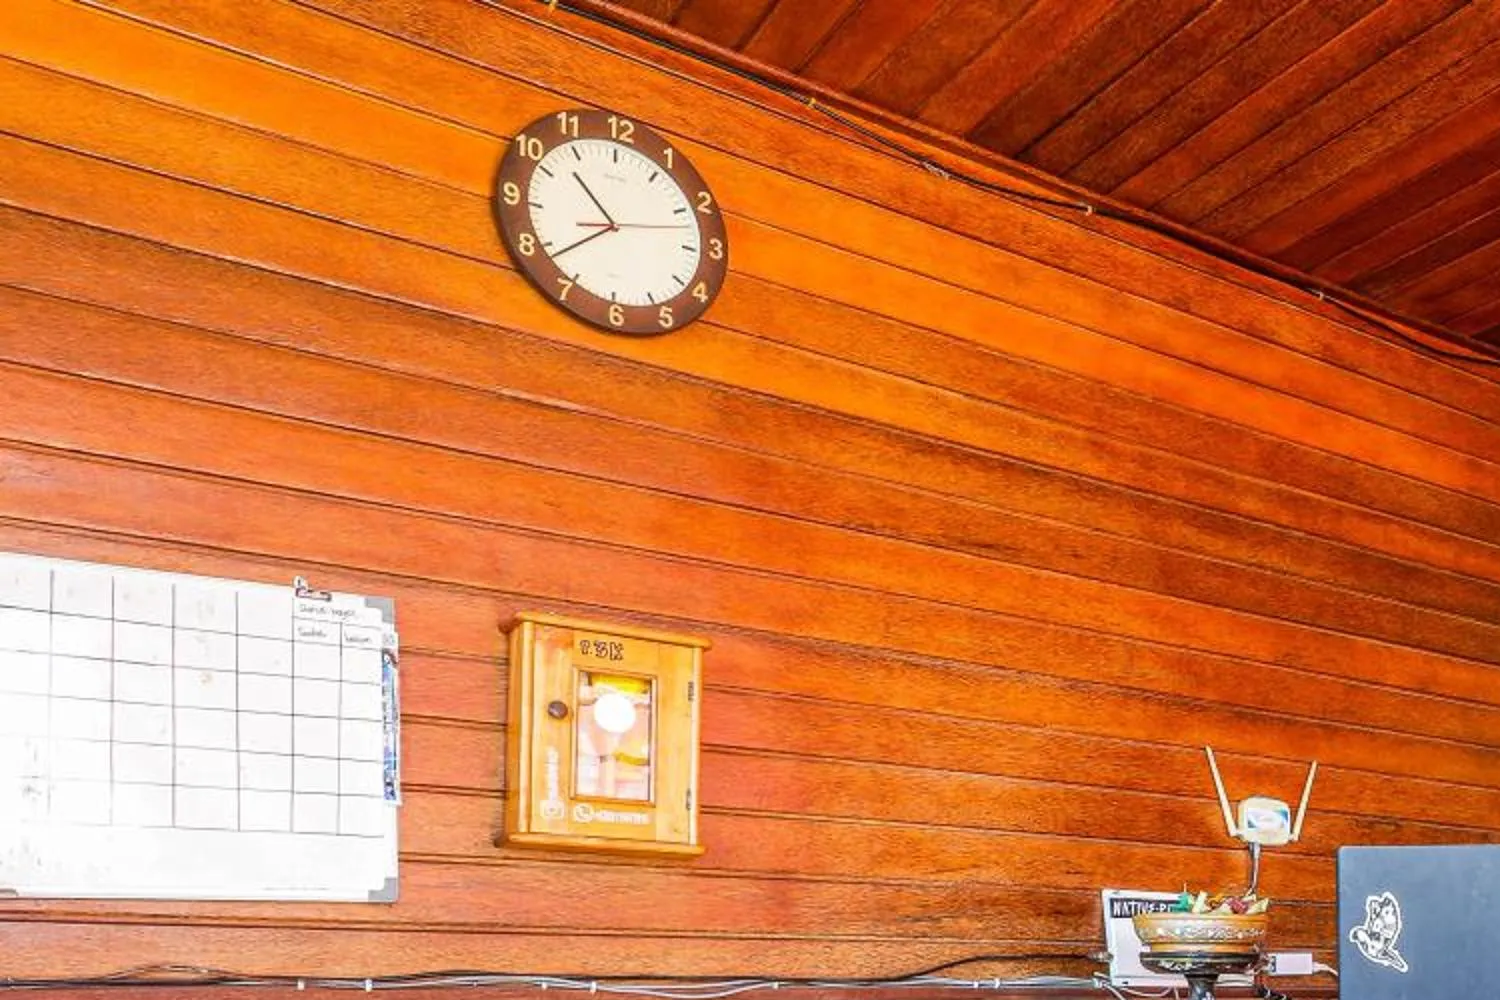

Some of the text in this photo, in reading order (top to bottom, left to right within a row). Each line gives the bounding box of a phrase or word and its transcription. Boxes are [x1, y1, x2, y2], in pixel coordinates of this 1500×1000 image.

[556, 111, 579, 137] 11
[607, 116, 635, 144] 12
[515, 134, 543, 160] 10
[663, 147, 674, 169] 1
[502, 182, 520, 205] 9
[697, 191, 712, 214] 2
[518, 233, 535, 256] 8
[708, 238, 723, 260] 3
[556, 278, 574, 301] 7
[692, 282, 709, 303] 4
[608, 304, 625, 327] 6
[658, 306, 674, 328] 5
